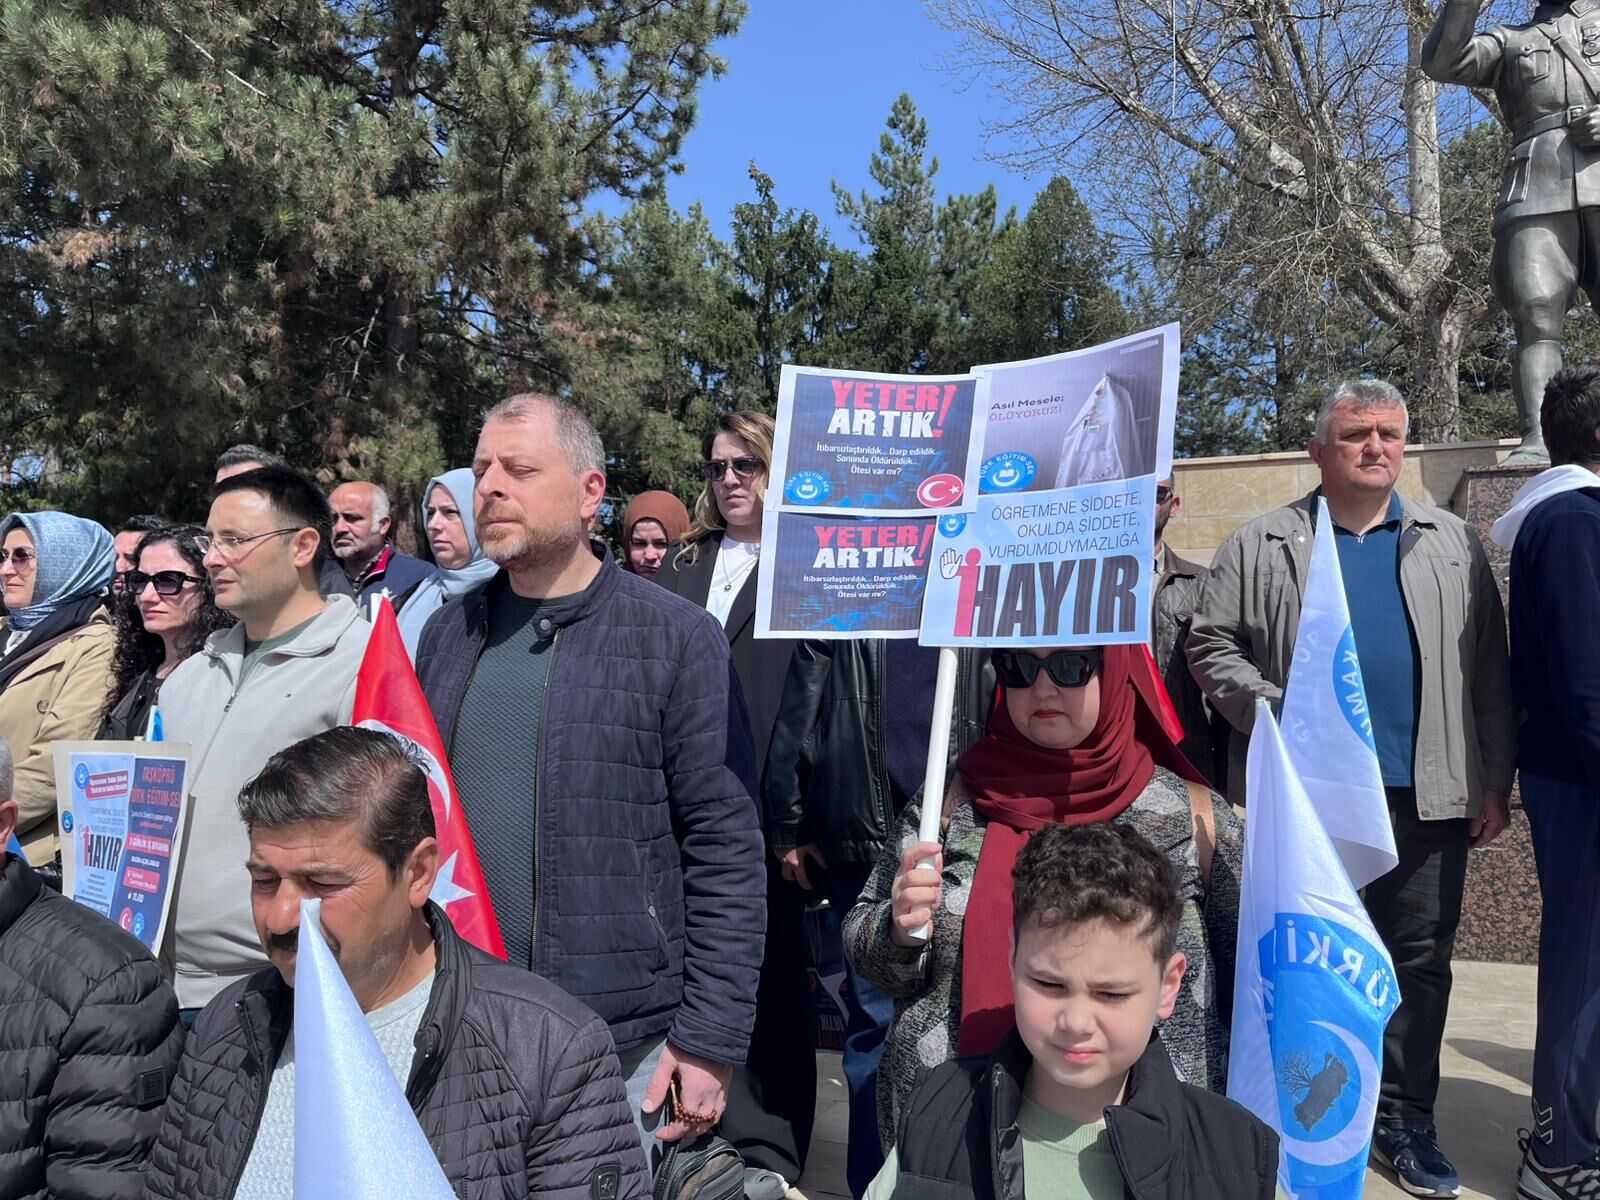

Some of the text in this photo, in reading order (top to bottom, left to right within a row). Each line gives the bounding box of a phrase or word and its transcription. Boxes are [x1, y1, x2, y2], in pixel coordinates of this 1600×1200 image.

[991, 401, 1015, 411] Asıl
[889, 447, 907, 457] Darp
[836, 454, 869, 464] Sonunda
[851, 464, 871, 475] Ötesi
[886, 466, 902, 476] mı?
[991, 491, 1142, 521] ÖĞRETMENE ŞİDDETE,
[1017, 511, 1140, 538] OKULDA ŞİDDETE,
[814, 524, 937, 567] YETER!
[988, 530, 1140, 559] VURDUMDUYMAZLIĞA
[812, 546, 916, 569] ARTIK
[873, 574, 892, 583] Darp
[823, 582, 855, 590] Sonunda
[837, 590, 857, 598] Ötesi
